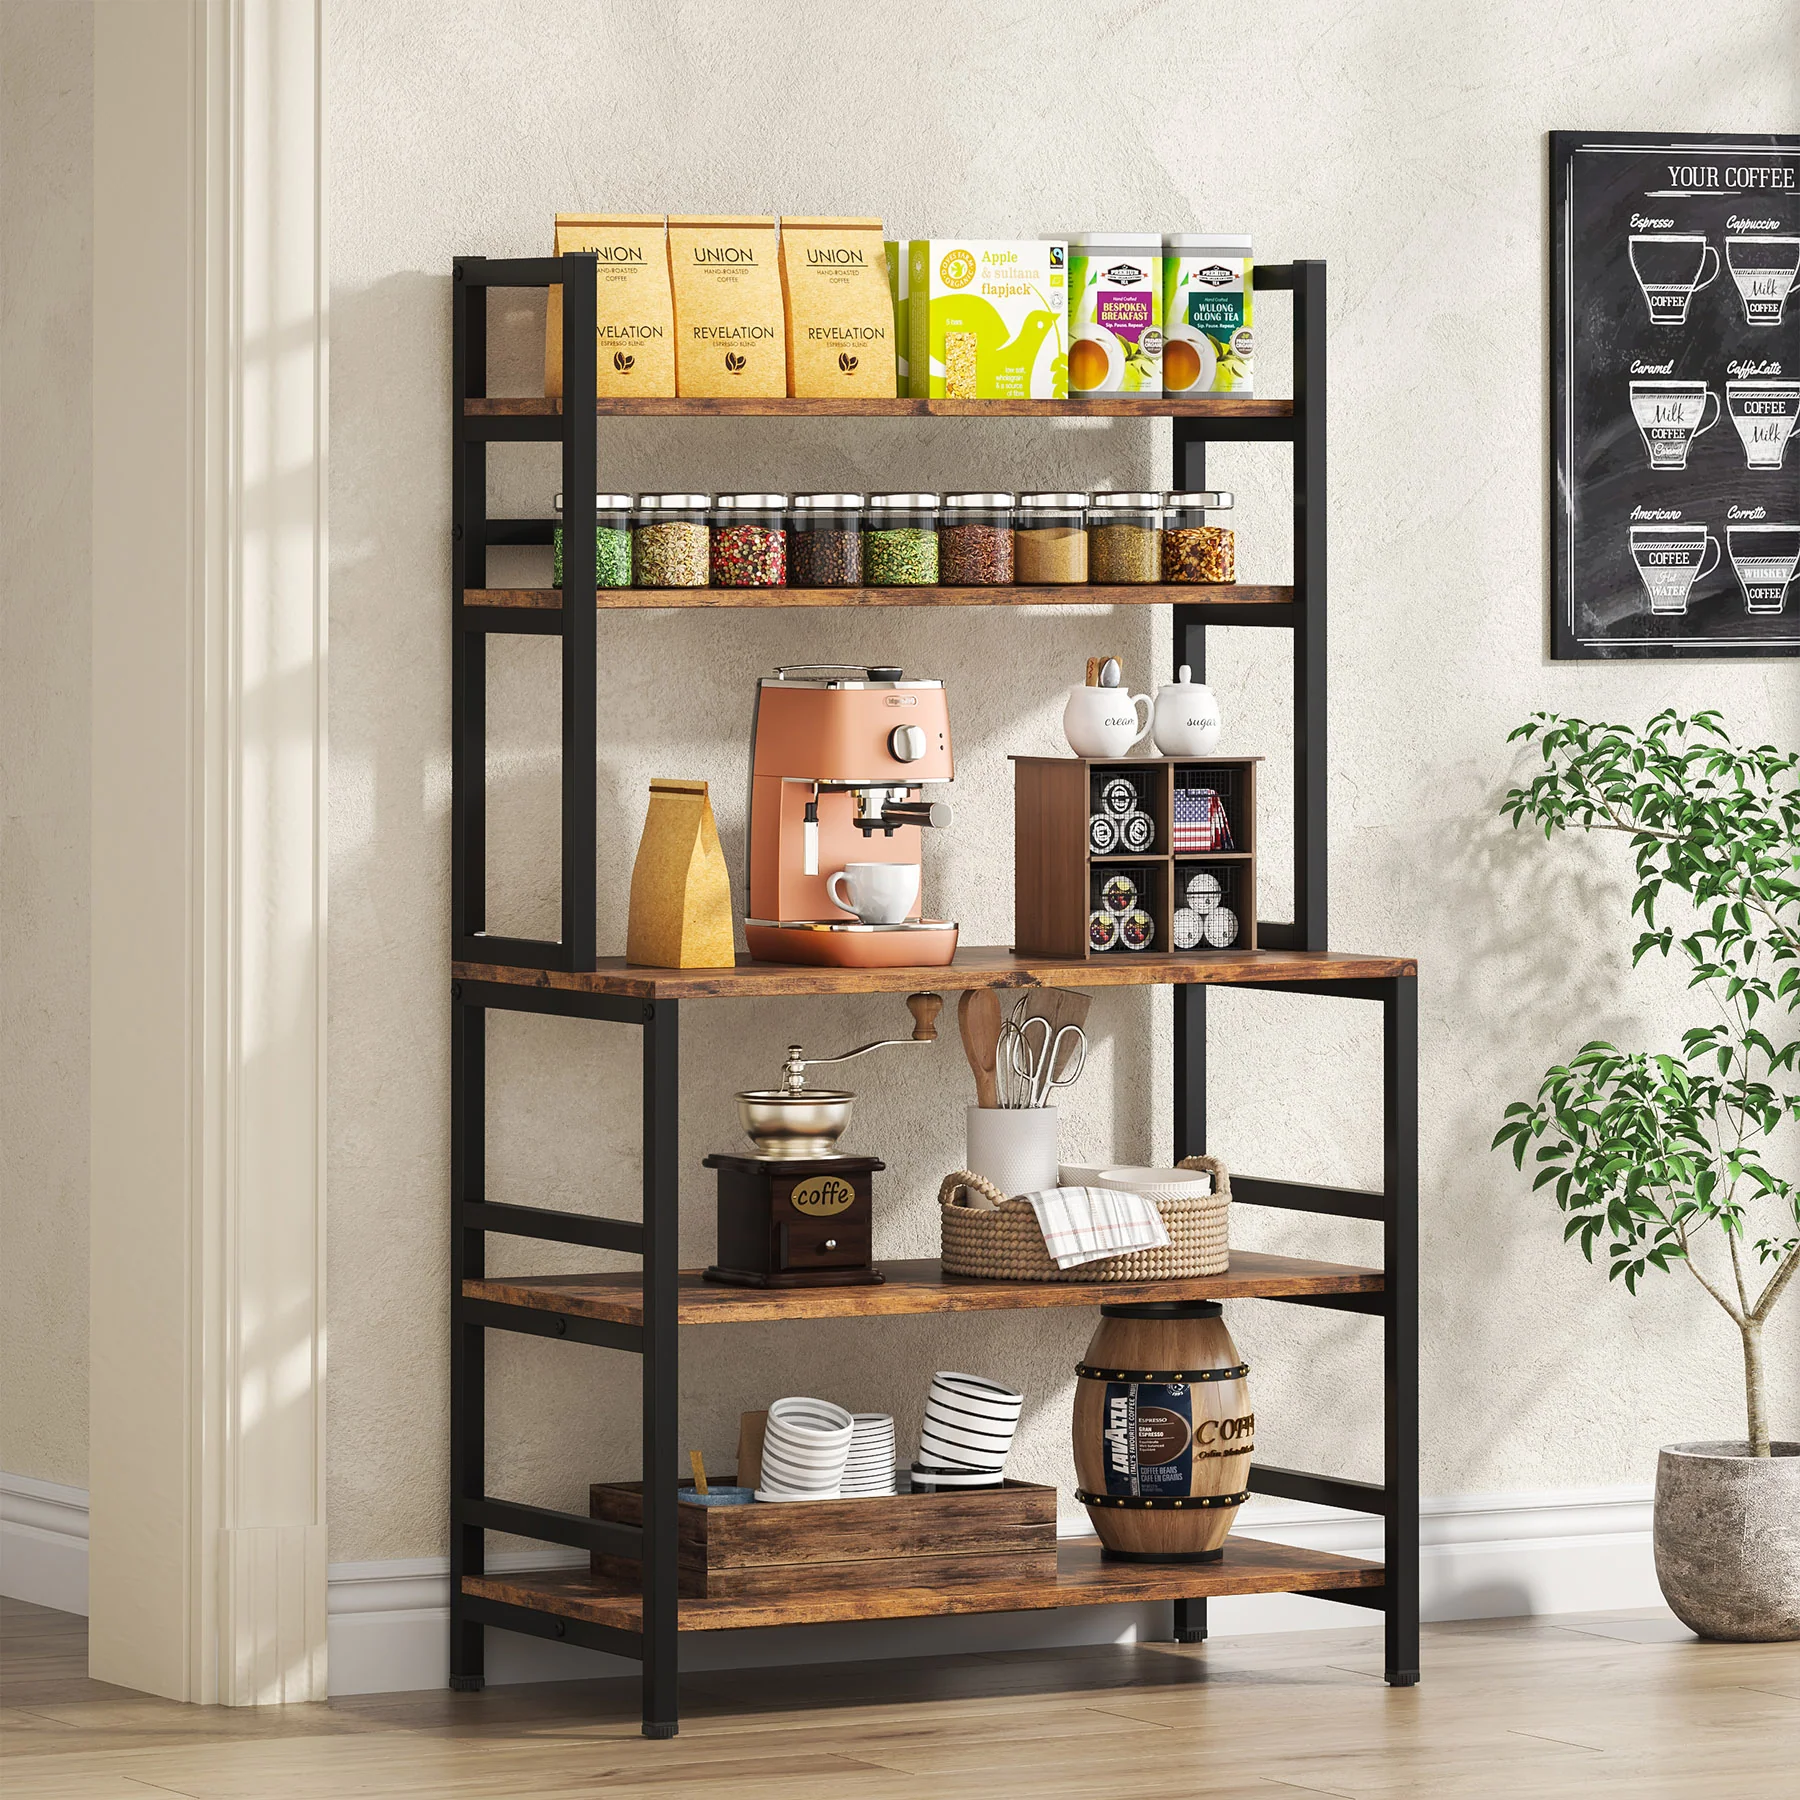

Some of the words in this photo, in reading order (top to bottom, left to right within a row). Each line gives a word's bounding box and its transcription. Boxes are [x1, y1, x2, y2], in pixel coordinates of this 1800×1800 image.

[1668, 166, 1719, 188] YOUR
[1725, 167, 1795, 188] COFFEE
[1630, 213, 1674, 232] Espresso
[1726, 215, 1781, 234] Cappuccino
[694, 247, 753, 262] UNION
[806, 249, 863, 263] UNION
[981, 250, 1018, 265] Apple
[982, 270, 991, 279] &
[994, 267, 1040, 279] sultana
[981, 283, 1031, 298] flapjack
[1752, 278, 1777, 298] Milk
[1103, 302, 1147, 312] BESPOKEN
[1199, 303, 1234, 313] WULONG
[1651, 296, 1685, 307] COFFEE
[1750, 303, 1779, 313] COFFEE
[1101, 311, 1148, 321] BREAKFAST
[1193, 312, 1222, 321] OLONG
[1224, 312, 1239, 322] TEA
[597, 326, 663, 338] VELATION
[693, 326, 774, 339] REVELATION
[808, 327, 885, 340] REVELATION
[1630, 359, 1674, 374] Caramel
[1652, 402, 1685, 424] Milk
[1744, 401, 1786, 414] COFFEE
[1651, 429, 1685, 439] COFFEE
[1750, 423, 1781, 443] Milk
[1630, 505, 1682, 520] Americano
[1727, 505, 1766, 519] Corretto
[1649, 552, 1690, 565] COFFEE
[1744, 568, 1788, 579] WHISKEY
[1651, 586, 1686, 597] WATER
[1750, 588, 1781, 599] COFFEE
[797, 1181, 849, 1205] coffe
[1128, 1398, 1136, 1421] COFFEE
[1105, 1397, 1130, 1475] LAVAZZA
[1140, 1467, 1159, 1475] COFFEE
[1160, 1466, 1178, 1474] BEANS
[1162, 1473, 1183, 1482] GRAINS
